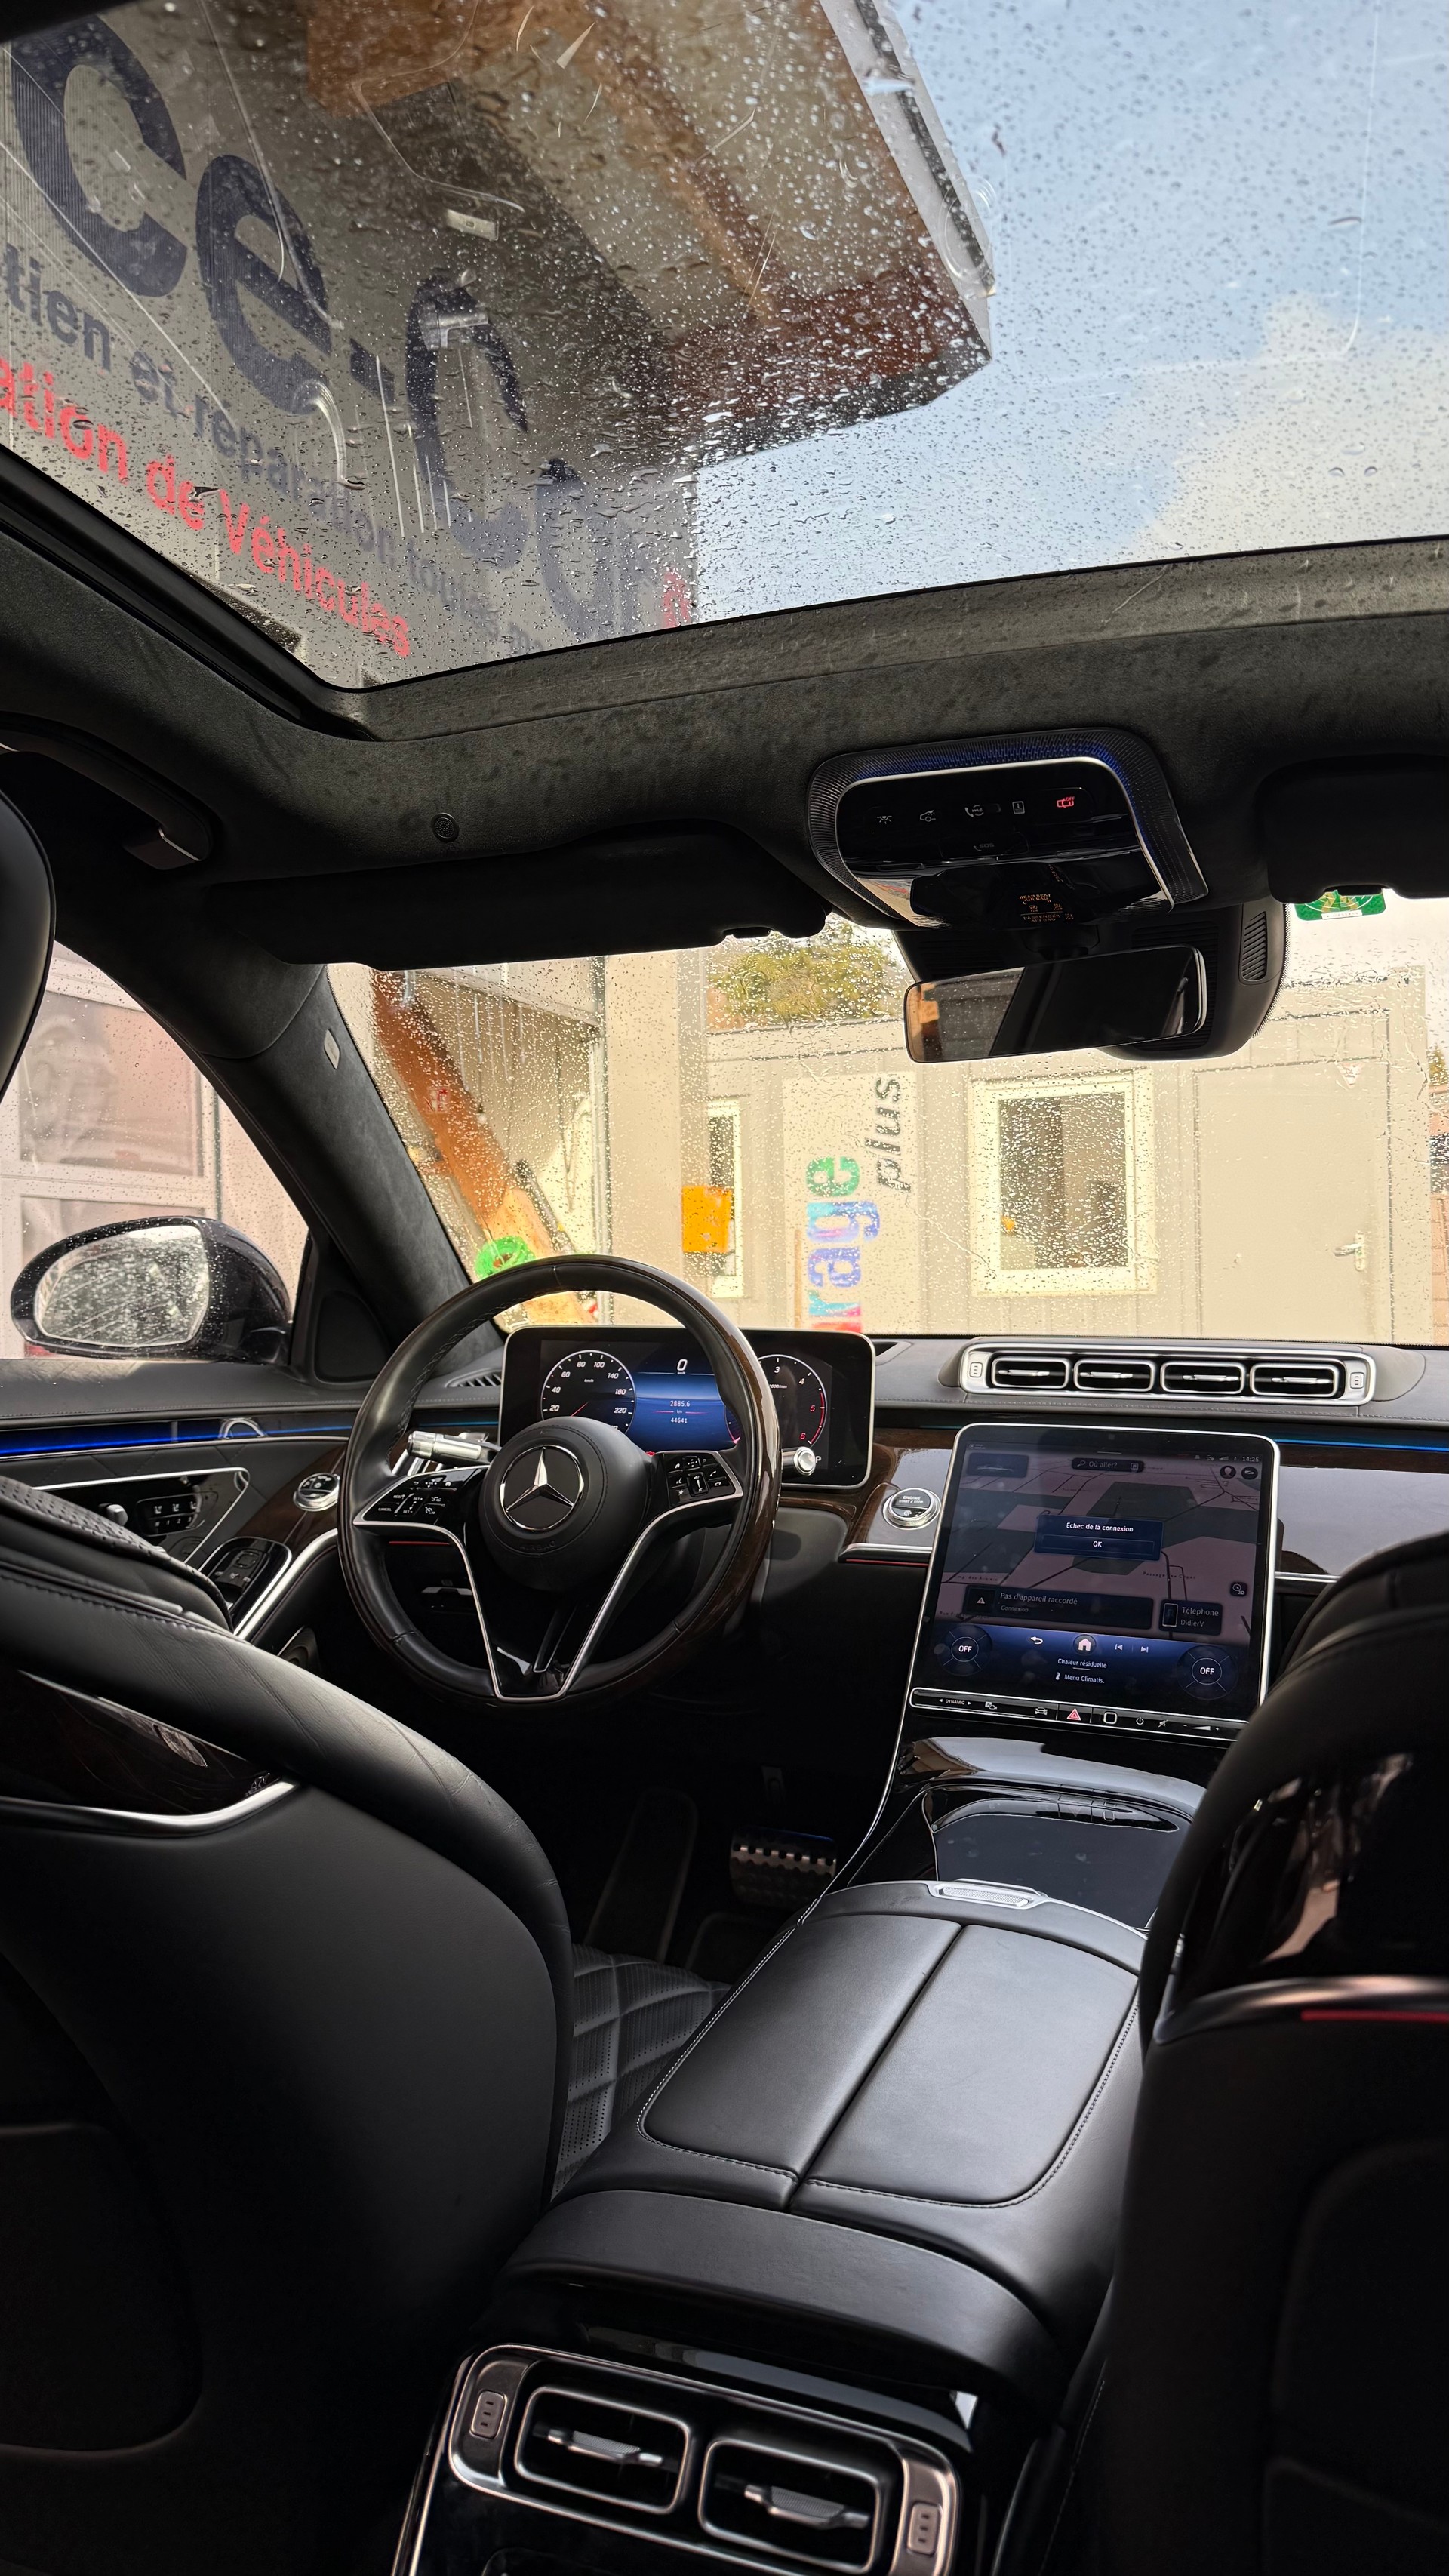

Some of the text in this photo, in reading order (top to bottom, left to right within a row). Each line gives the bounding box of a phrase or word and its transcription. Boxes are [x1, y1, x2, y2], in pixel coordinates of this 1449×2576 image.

[130, 350, 178, 420] et
[146, 453, 205, 531] de
[219, 488, 410, 658] Véhicules
[864, 1077, 912, 1193] plus
[676, 1359, 688, 1371] 0
[815, 1455, 822, 1463] P
[1088, 1460, 1097, 1468] Où
[1066, 1522, 1084, 1530] Echec
[1000, 1592, 1078, 1605] Pas d'appareil raccordé
[1001, 1605, 1029, 1613] Connexion
[1182, 1606, 1220, 1617] Téléphone
[1180, 1619, 1204, 1627] DidierV
[958, 1645, 973, 1653] OFF
[1057, 1657, 1107, 1669] Chaleur résiduelle
[1199, 1667, 1215, 1676] OFF
[1064, 1673, 1105, 1684] Menu Climatis.
